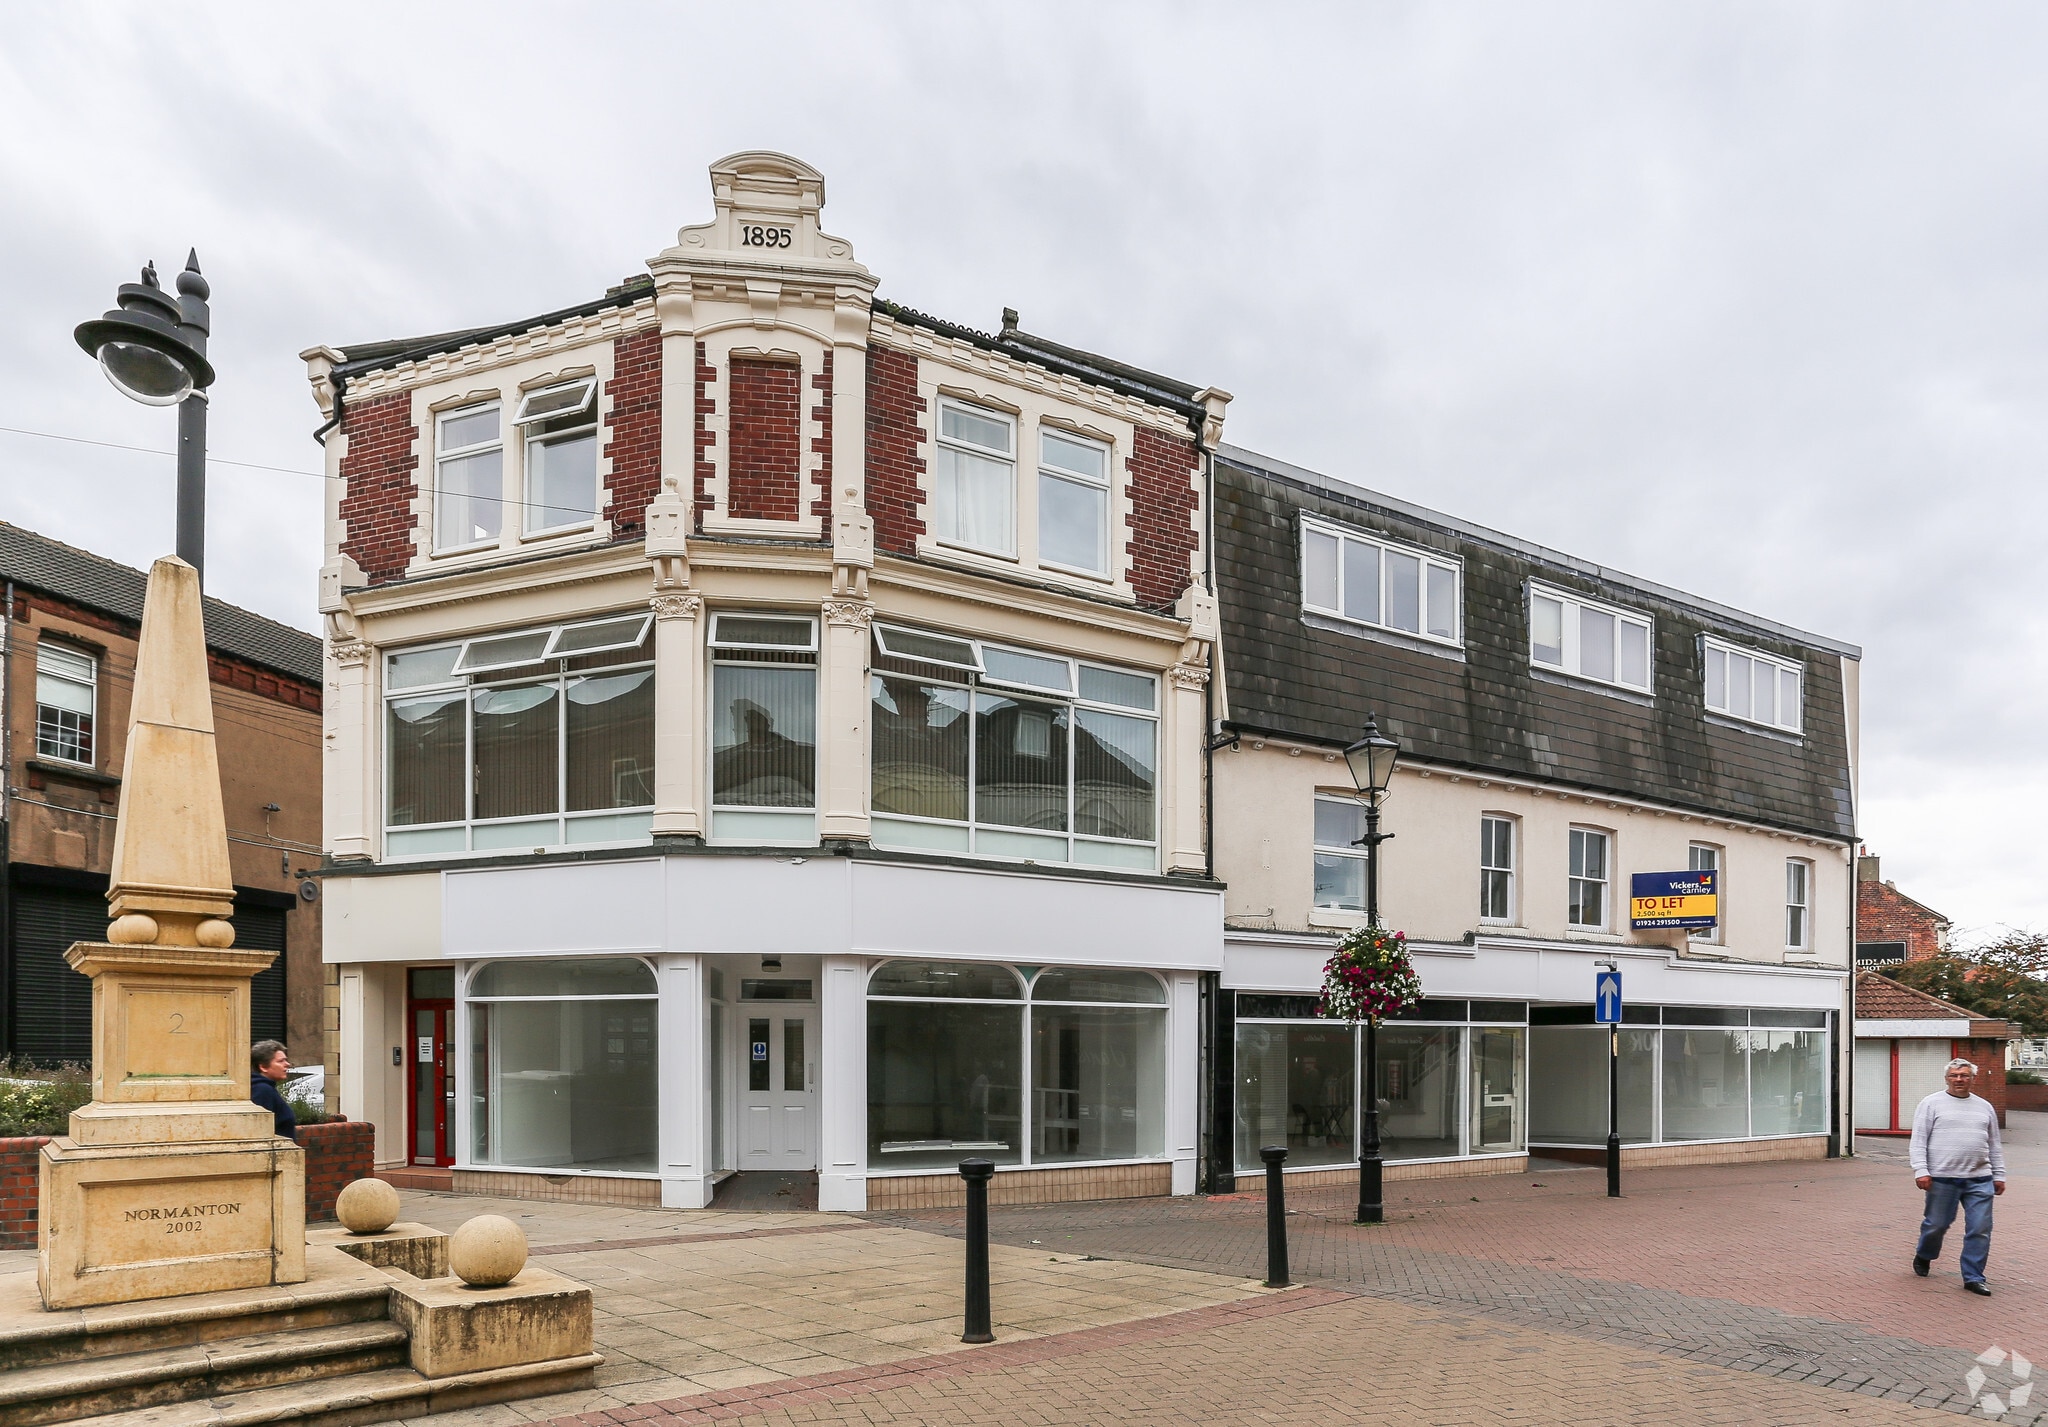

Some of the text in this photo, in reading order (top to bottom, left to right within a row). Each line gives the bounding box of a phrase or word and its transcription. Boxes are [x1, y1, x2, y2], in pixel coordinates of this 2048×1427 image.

[742, 226, 791, 248] 1895
[1669, 881, 1699, 889] Vickers
[1681, 886, 1711, 895] carnley
[1636, 897, 1685, 909] TO LET
[169, 1012, 189, 1034] 2
[125, 1202, 241, 1222] NORMANTON
[166, 1221, 202, 1234] 2002
